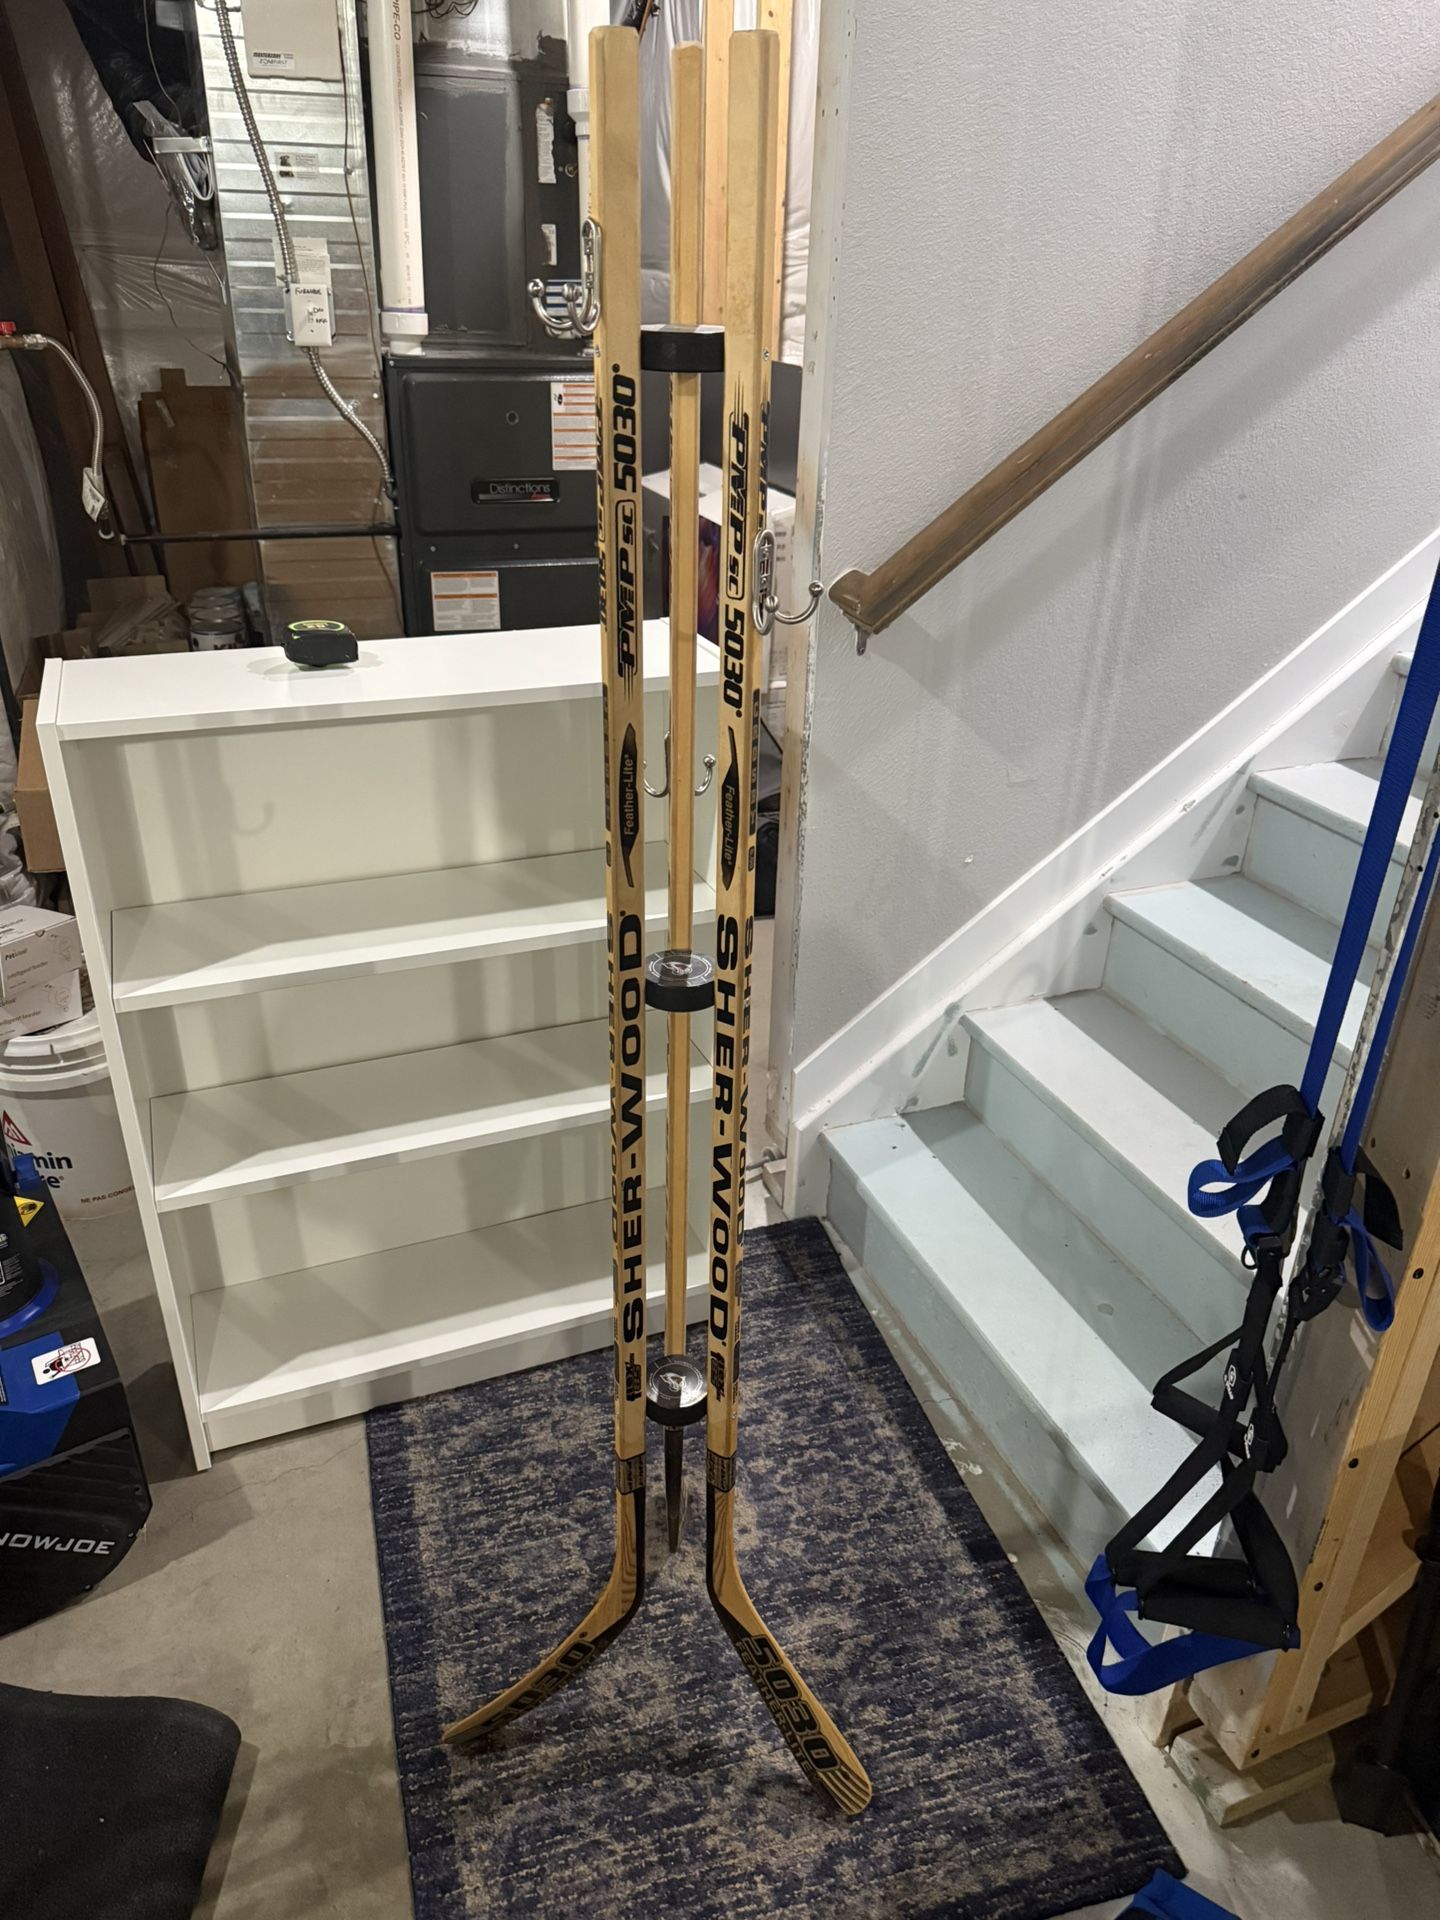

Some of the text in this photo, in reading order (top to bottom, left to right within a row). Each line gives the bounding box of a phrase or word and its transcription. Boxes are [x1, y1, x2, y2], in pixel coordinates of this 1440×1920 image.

[489, 482, 552, 495] Distinctions
[612, 373, 637, 494] 5030
[724, 604, 745, 709] 5030
[619, 913, 644, 1344] SHER-WOOD
[710, 914, 739, 1344] SHER-WOOD
[743, 1633, 841, 1772] 5030
